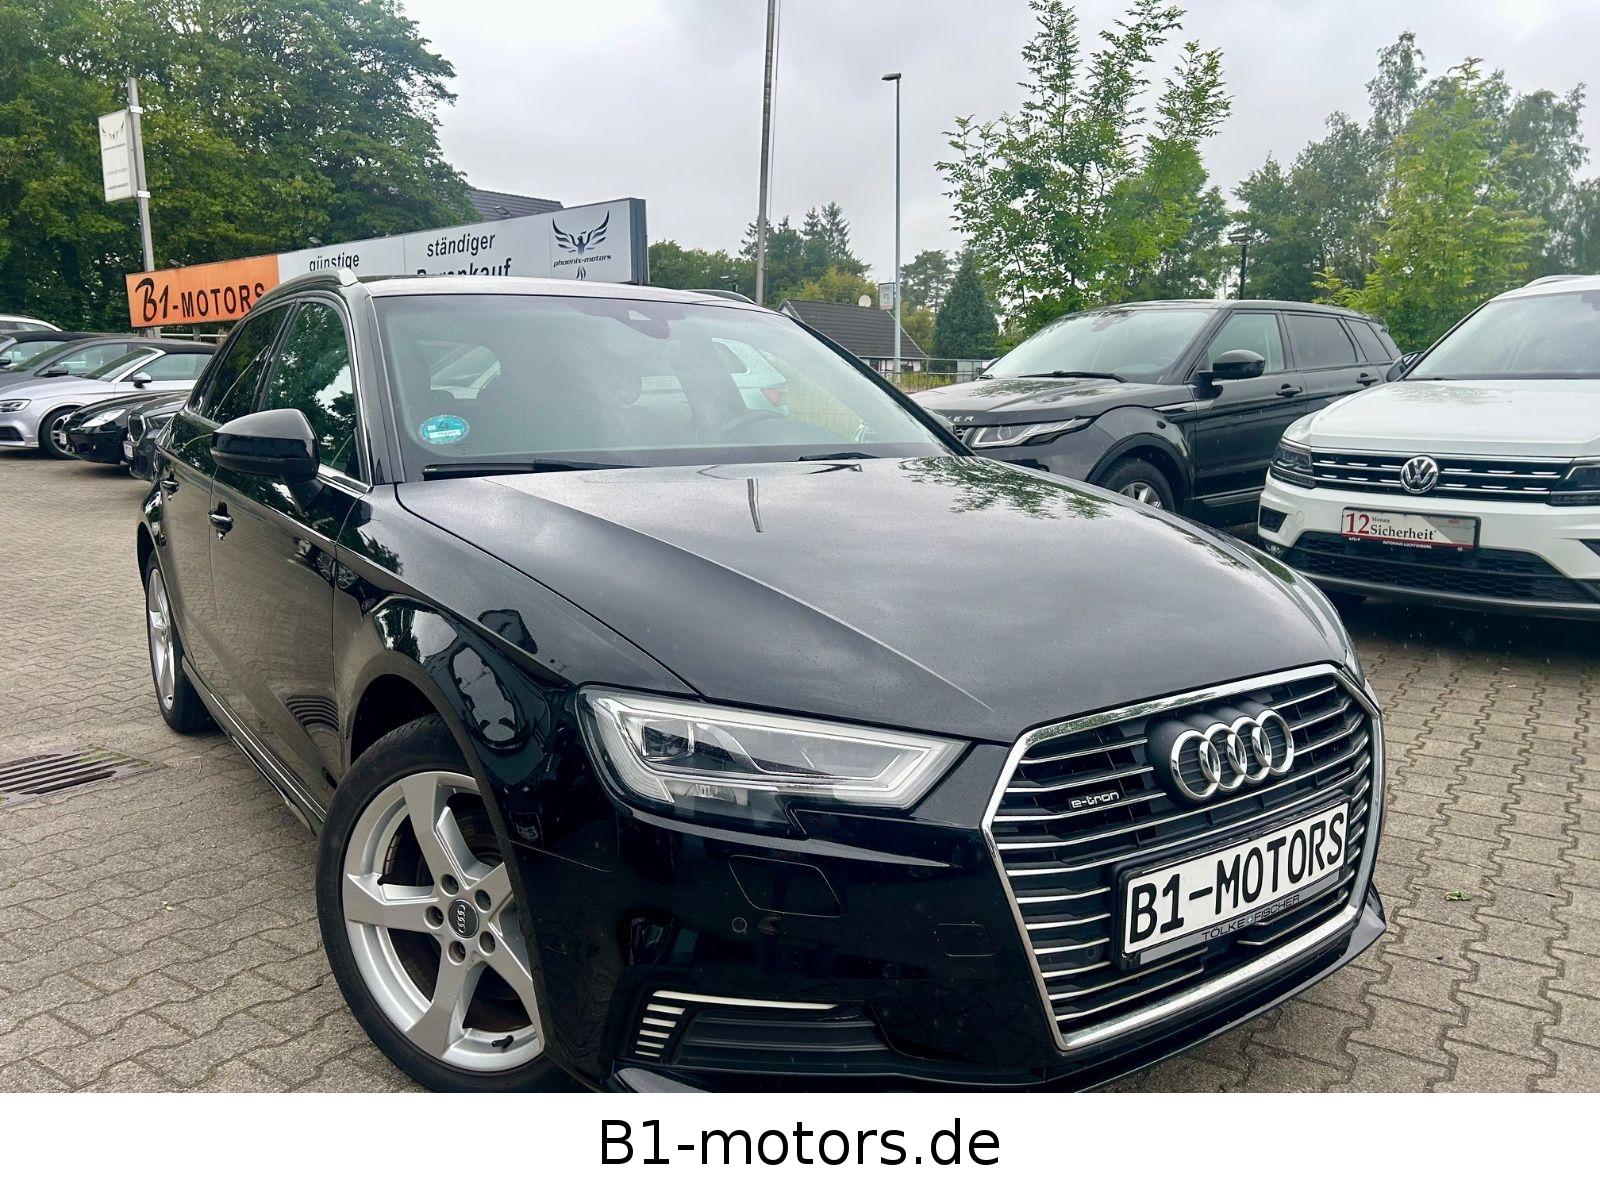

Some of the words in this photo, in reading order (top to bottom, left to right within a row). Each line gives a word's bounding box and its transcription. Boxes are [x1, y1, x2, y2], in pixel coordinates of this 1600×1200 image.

[427, 233, 496, 257] ständiger
[309, 252, 360, 272] günstige
[553, 255, 612, 268] phoenix-motors
[1346, 512, 1370, 535] 12
[1071, 791, 1120, 808] e-tron
[1129, 812, 1345, 944] B1-MOTORS
[1254, 894, 1300, 921] FISCHER
